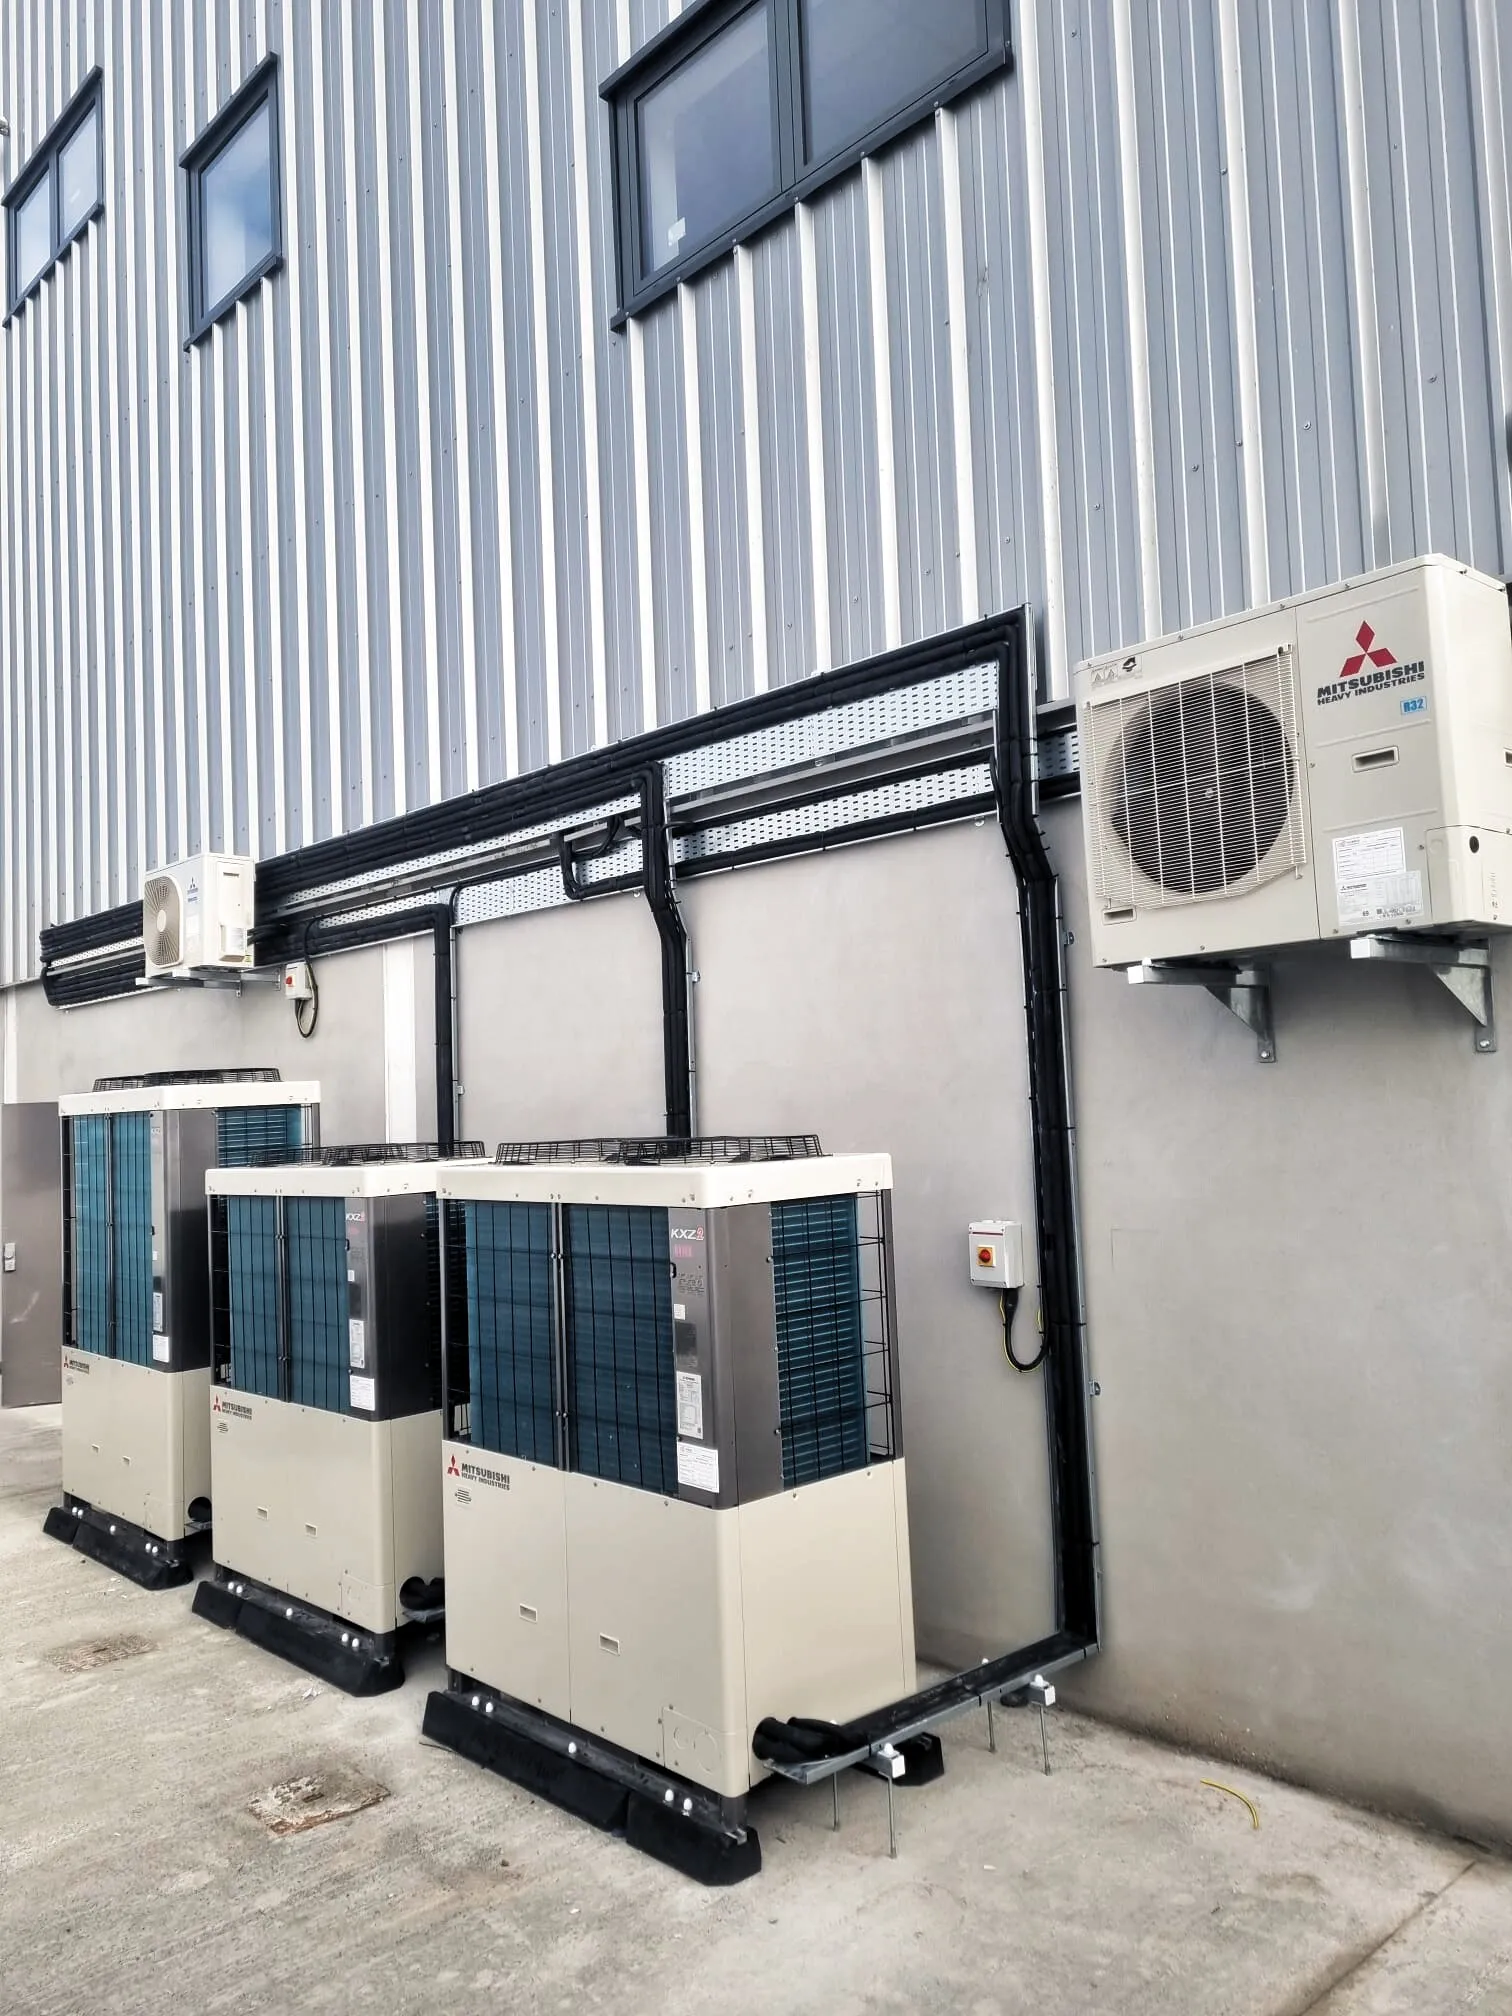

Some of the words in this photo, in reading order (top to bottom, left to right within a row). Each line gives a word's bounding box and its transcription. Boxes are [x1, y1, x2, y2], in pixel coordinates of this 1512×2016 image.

[1317, 661, 1425, 698] MITSUBISHI
[1317, 691, 1352, 706] HEAVY
[1355, 673, 1425, 696] INDUSTRIES
[461, 1463, 510, 1484] MITSUBISHI
[461, 1472, 477, 1481] HEAVY
[478, 1477, 510, 1491] INDUSTRIES
